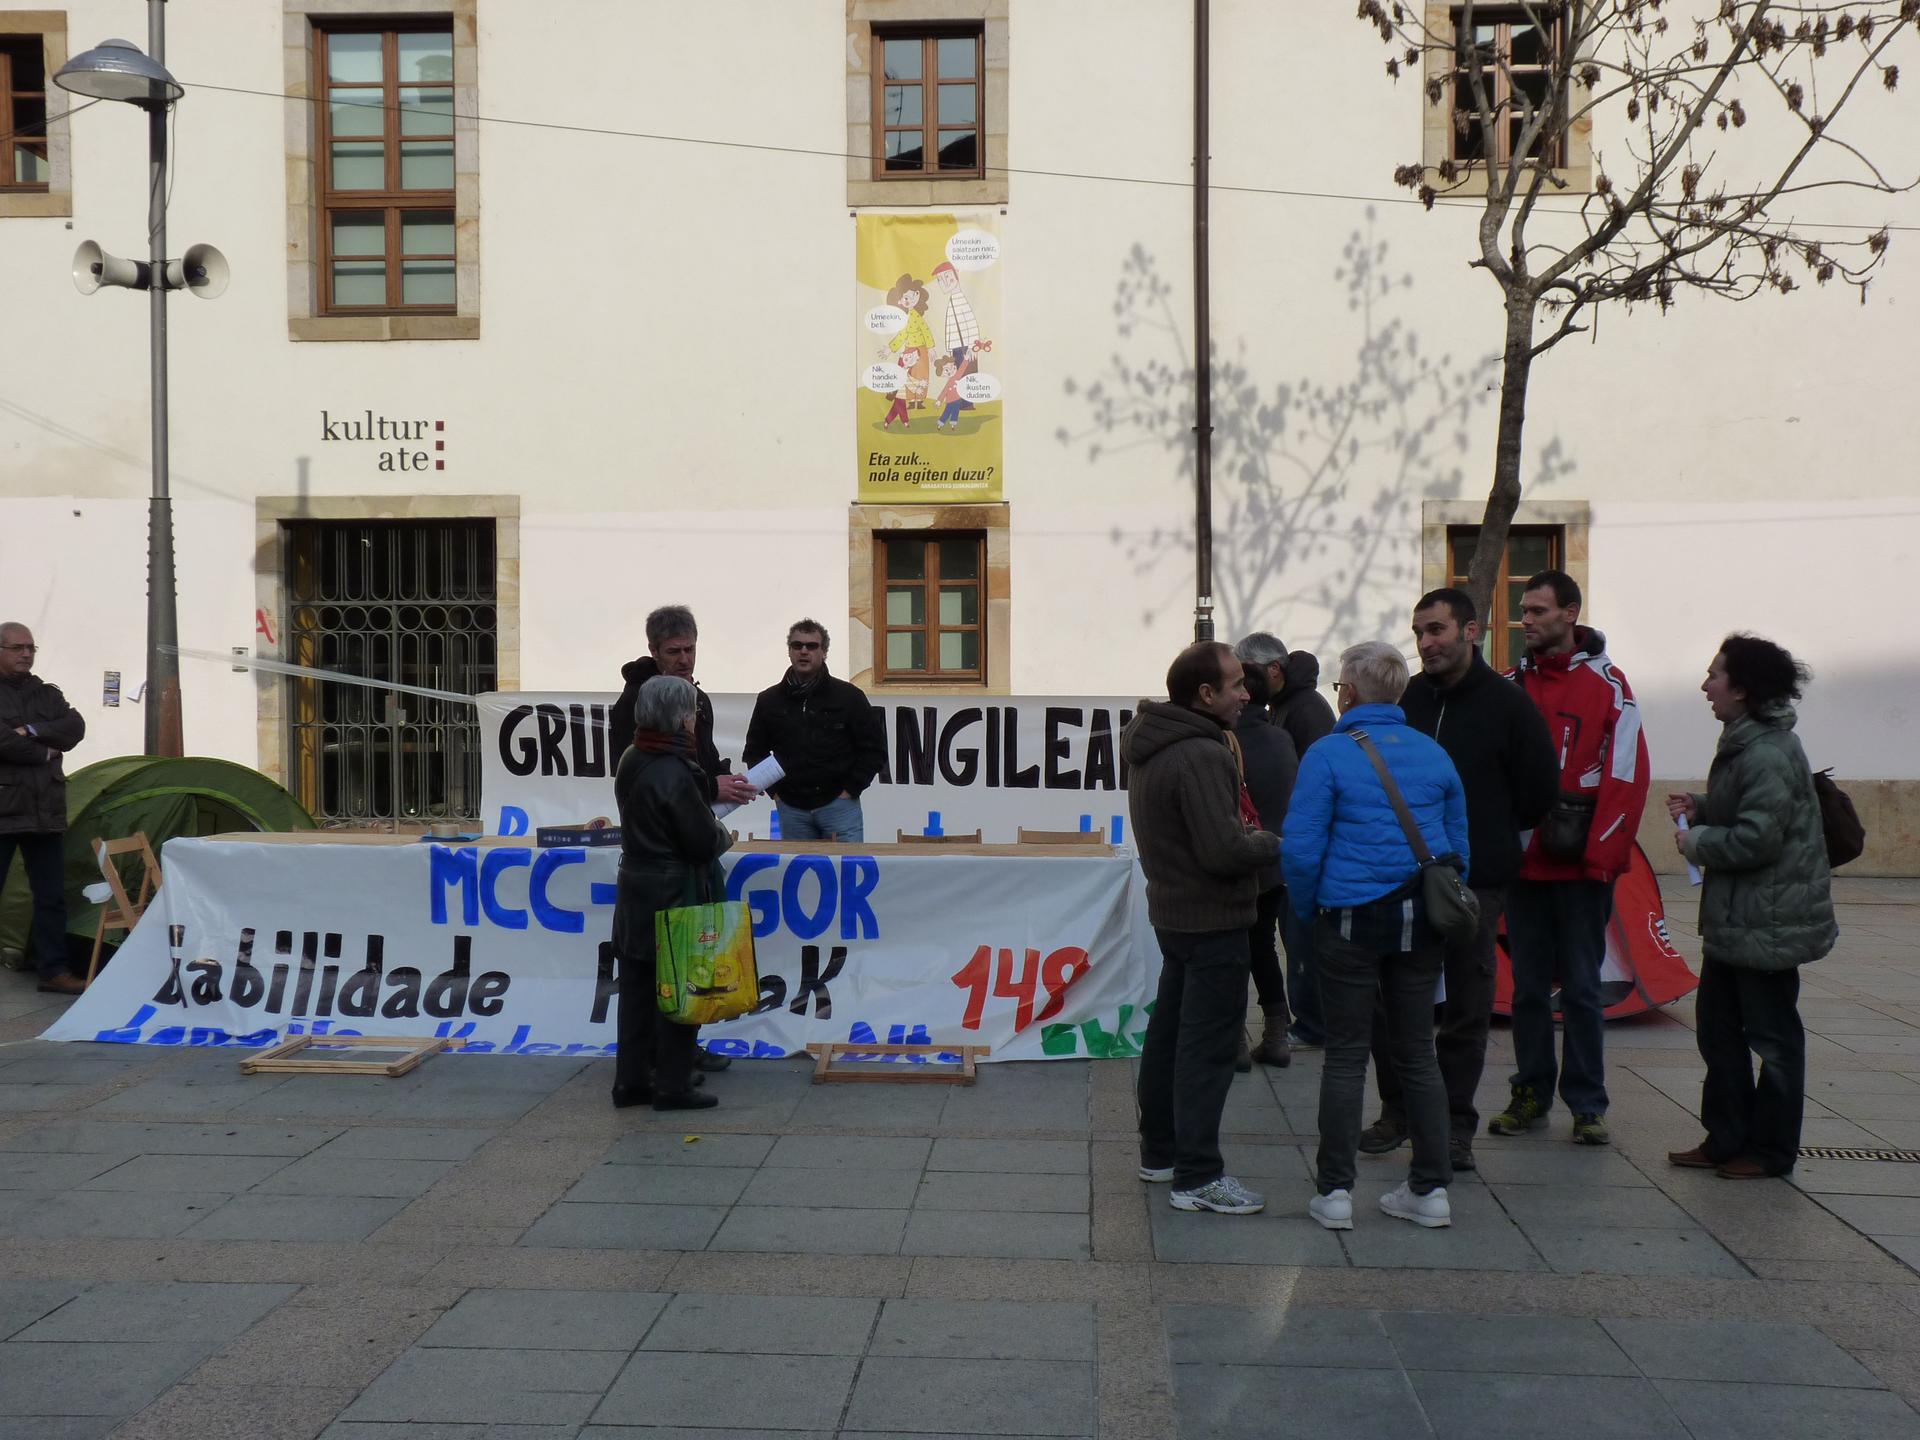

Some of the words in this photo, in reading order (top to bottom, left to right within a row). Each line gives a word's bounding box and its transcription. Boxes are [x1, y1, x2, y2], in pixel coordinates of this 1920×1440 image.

[320, 410, 429, 441] kultur
[378, 447, 429, 472] ate
[868, 452, 891, 466] Eta
[894, 451, 930, 466] zuk...
[868, 468, 900, 482] nola
[903, 467, 948, 485] egiten
[952, 466, 994, 481] duzu?
[499, 704, 617, 777] GRU
